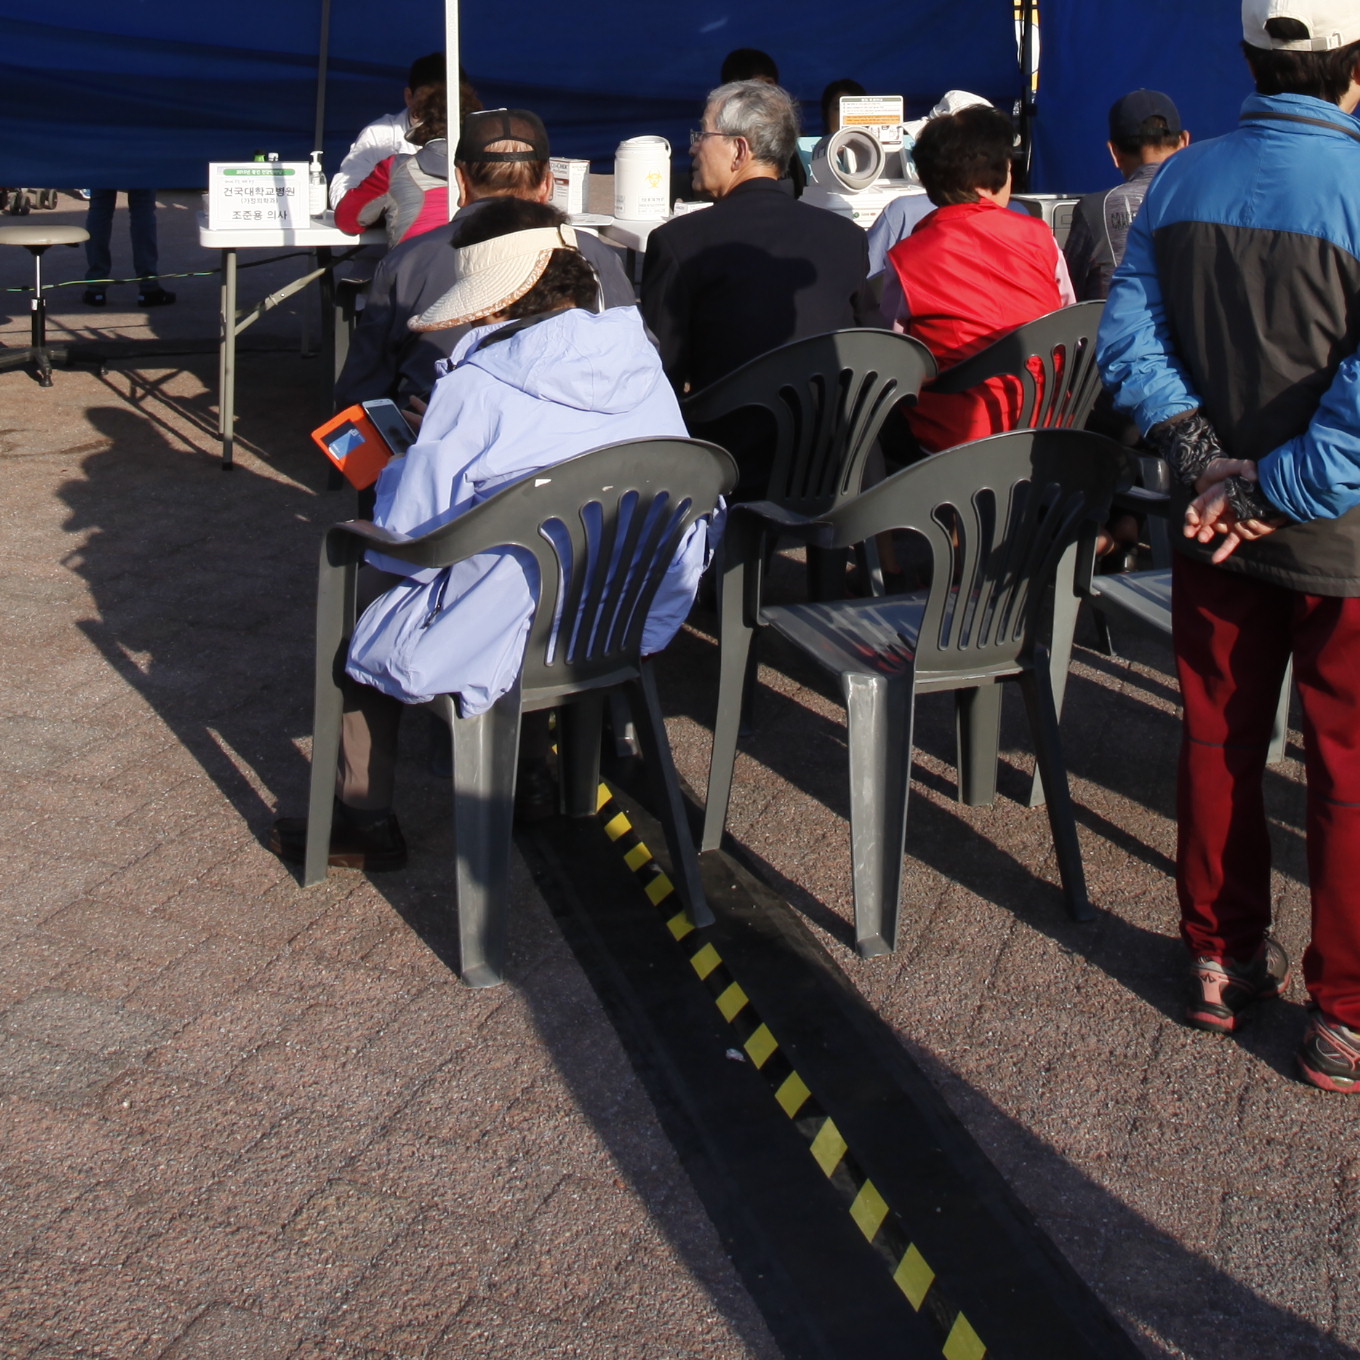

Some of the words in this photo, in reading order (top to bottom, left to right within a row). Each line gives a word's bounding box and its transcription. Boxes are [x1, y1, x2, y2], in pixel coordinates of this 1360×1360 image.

[223, 186, 295, 197] 건국대학교병원
[232, 210, 263, 220] 조준용
[267, 209, 288, 220] 의사
